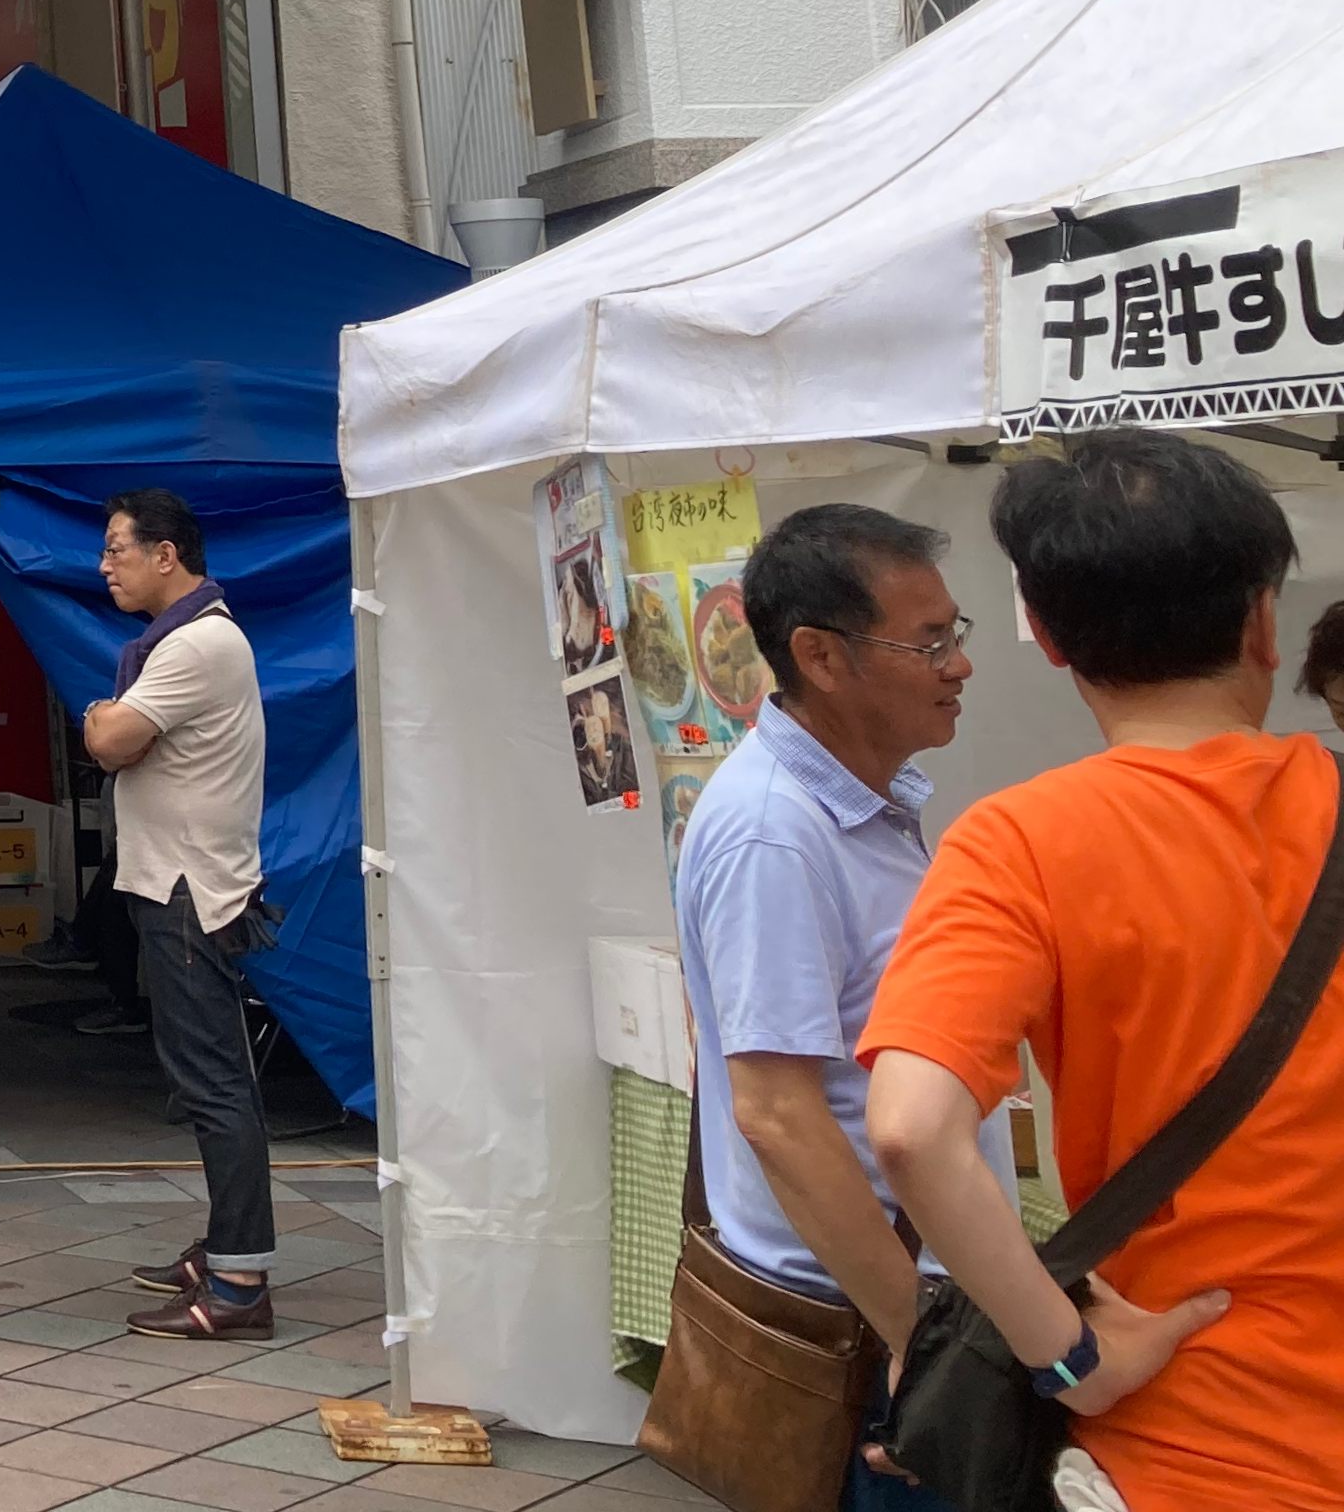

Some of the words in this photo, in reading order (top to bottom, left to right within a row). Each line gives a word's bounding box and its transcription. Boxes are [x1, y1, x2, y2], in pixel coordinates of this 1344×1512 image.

[631, 481, 737, 534] 台湾夜市の味
